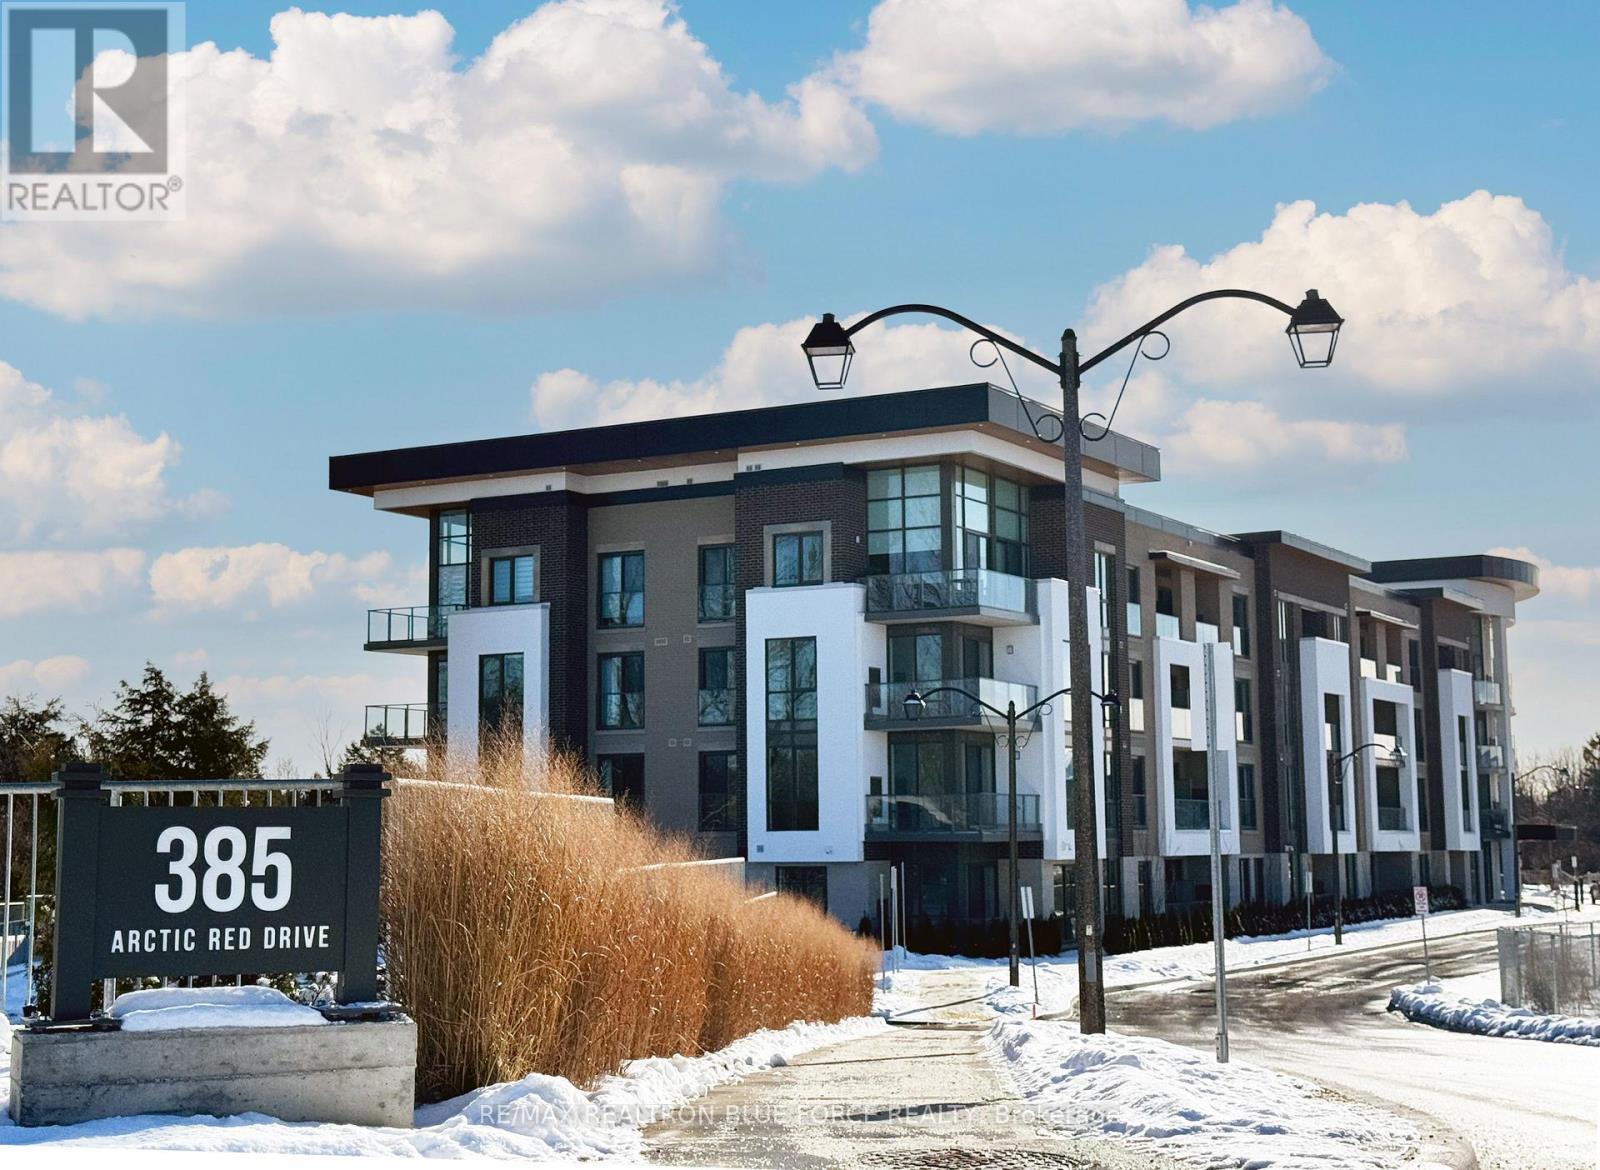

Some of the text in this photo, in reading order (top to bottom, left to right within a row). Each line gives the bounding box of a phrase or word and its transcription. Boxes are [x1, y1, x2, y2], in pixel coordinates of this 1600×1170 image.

[155, 826, 292, 913] 385
[111, 925, 330, 953] ARCTIC RED DRIVE
